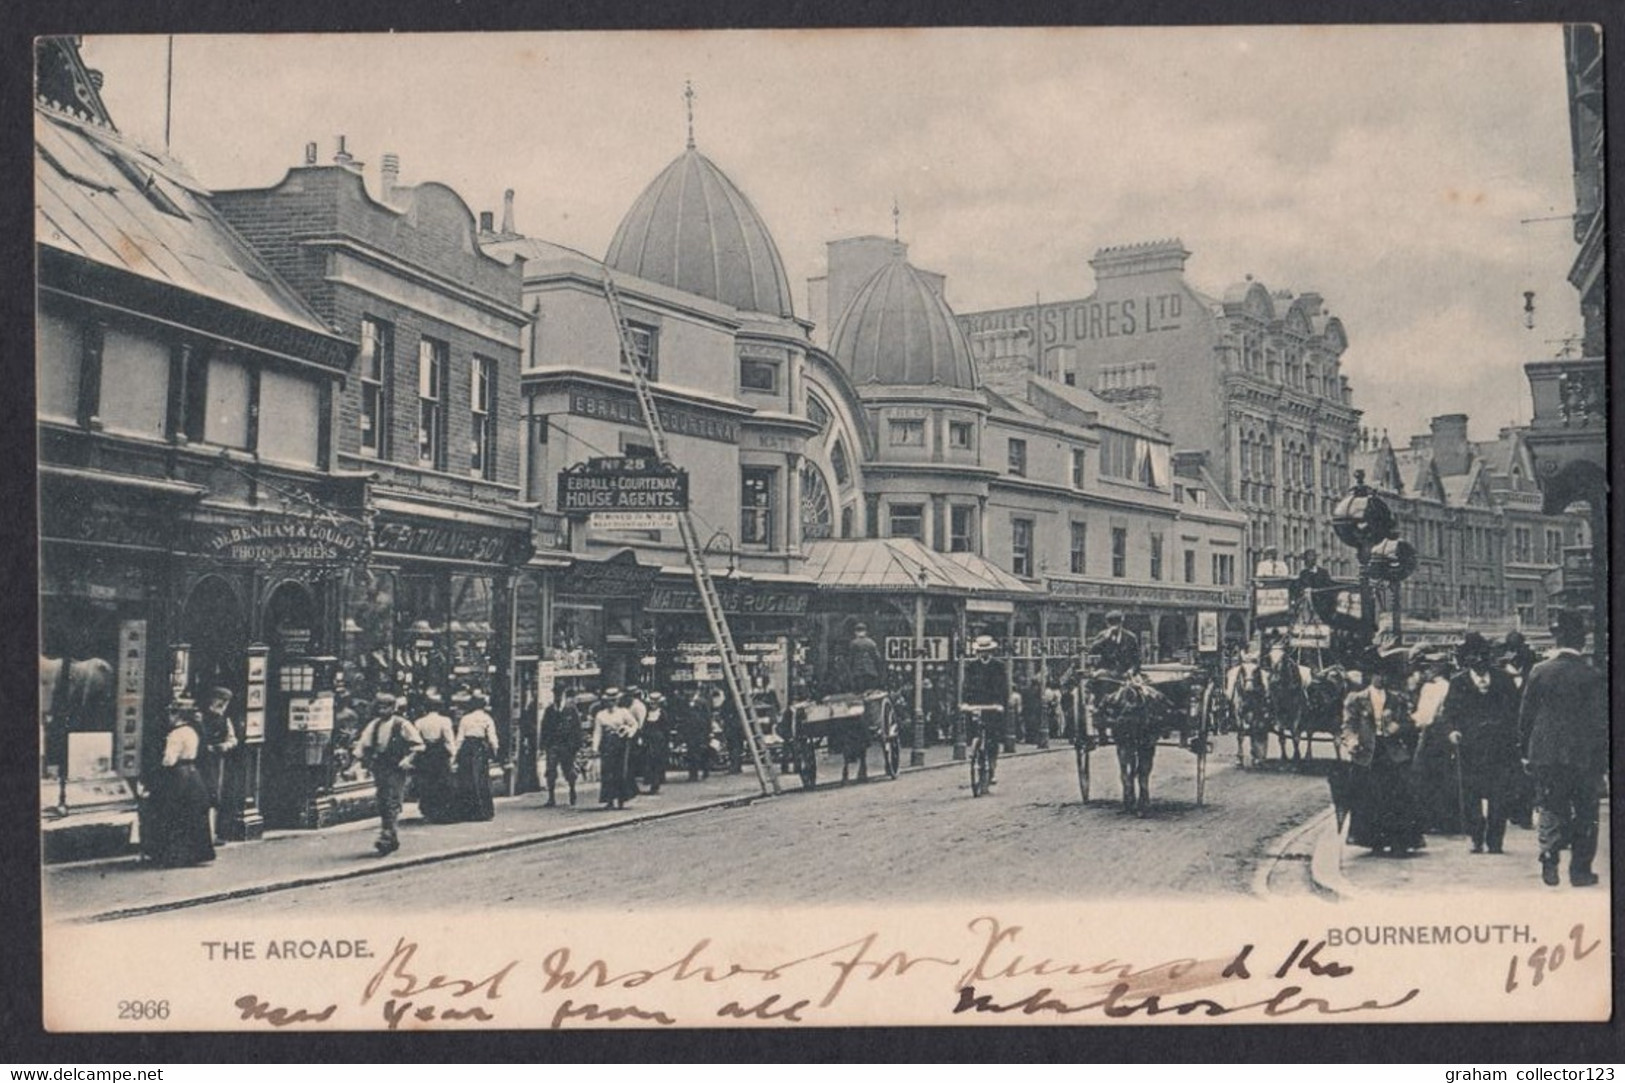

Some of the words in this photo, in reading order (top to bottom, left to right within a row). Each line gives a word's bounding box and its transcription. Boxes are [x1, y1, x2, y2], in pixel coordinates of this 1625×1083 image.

[1044, 299, 1136, 344] STORES
[575, 396, 638, 422] EBRALL
[567, 477, 608, 490] EBRALL
[566, 492, 613, 507] HOUSE
[617, 491, 680, 506] AGENTS.
[231, 544, 338, 559] PHOTOGRAPHERS
[1326, 924, 1537, 947] BOURNEMOUTH.
[201, 940, 257, 961] THE
[265, 940, 375, 960] ARCADE.
[1506, 922, 1602, 994] 1902
[361, 936, 518, 1006] Best
[116, 998, 171, 1021] 2966
